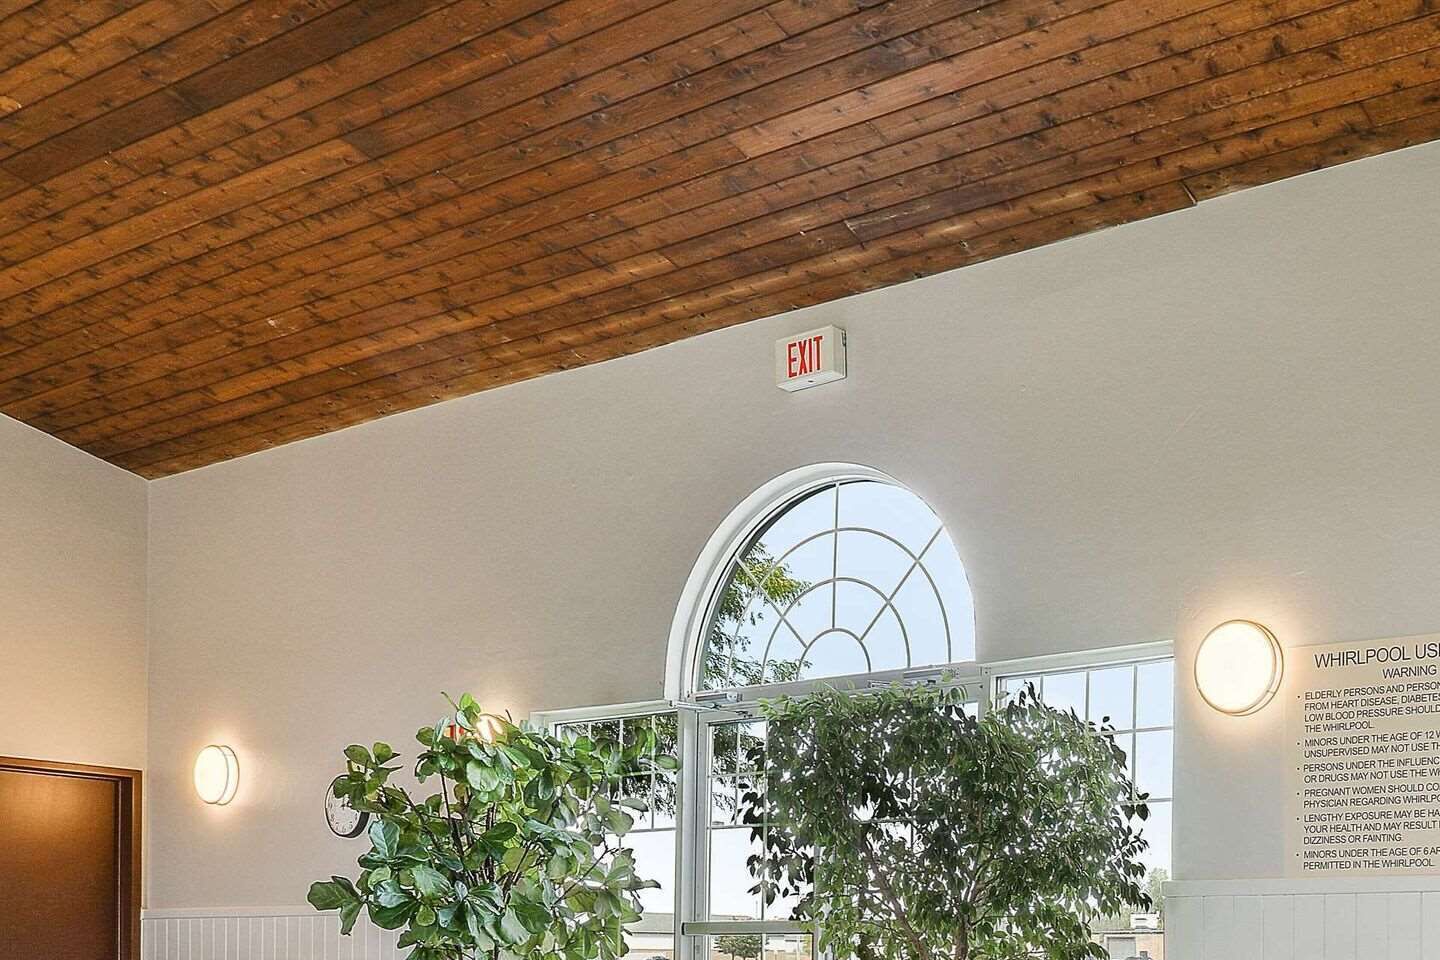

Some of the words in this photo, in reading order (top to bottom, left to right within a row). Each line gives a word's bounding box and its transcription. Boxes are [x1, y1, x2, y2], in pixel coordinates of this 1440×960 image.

[787, 335, 823, 378] EXIT
[1314, 645, 1411, 669] WHIRLPOOL
[1382, 664, 1437, 679] WARNING
[1304, 689, 1342, 701] ELDERLY
[1343, 685, 1385, 697] PERSONS
[1385, 684, 1405, 694] AND
[1304, 701, 1329, 711] FROM
[1331, 698, 1359, 709] HEART
[1304, 713, 1324, 722] LOW
[1325, 710, 1355, 721] BLOOD
[1356, 707, 1404, 718] PRESSURE
[1305, 724, 1321, 733] THE
[1304, 737, 1338, 747] MINORS
[1339, 734, 1370, 745] UNDER
[1371, 733, 1389, 742] THE
[1389, 732, 1409, 741] AGE
[1410, 731, 1422, 740] OF
[1425, 730, 1434, 739] 12
[1304, 746, 1370, 758] UNSUPERVISED
[1371, 745, 1390, 754] MAY
[1391, 743, 1410, 753] NOT
[1411, 742, 1429, 752] USE
[1303, 762, 1344, 773] PERSONS
[1346, 760, 1376, 770] UNDER
[1377, 758, 1395, 768] THE
[1304, 774, 1318, 783] OR
[1318, 773, 1349, 783] DRUGS
[1350, 772, 1369, 781] MAY
[1370, 770, 1389, 780] NOT
[1390, 769, 1408, 779] USE
[1409, 768, 1427, 778] THE
[1304, 786, 1351, 797] PREGNANT
[1351, 785, 1386, 795] WOMEN
[1387, 783, 1424, 793] SHOULD
[1303, 799, 1348, 808] PHYSICIAN
[1349, 795, 1401, 806] REGARDING
[1304, 812, 1344, 822] LENGTHY
[1345, 810, 1392, 821] EXPOSURE
[1394, 809, 1413, 819] MAY
[1413, 809, 1426, 818] BE
[1303, 824, 1328, 834] YOUR
[1329, 823, 1362, 833] HEALTH
[1363, 822, 1382, 831] AND
[1383, 821, 1402, 831] MAY
[1403, 820, 1438, 830] RESULT
[1303, 835, 1347, 845] DIZZINESS
[1347, 834, 1361, 844] OR
[1303, 849, 1337, 859] MINORS
[1338, 848, 1369, 858] UNDER
[1370, 848, 1388, 857] THE
[1388, 847, 1408, 856] AGE
[1408, 847, 1422, 856] OF
[1423, 846, 1429, 856] 6
[1303, 860, 1352, 870] PERMITTED
[1352, 860, 1361, 869] IN
[1363, 859, 1380, 869] THE
